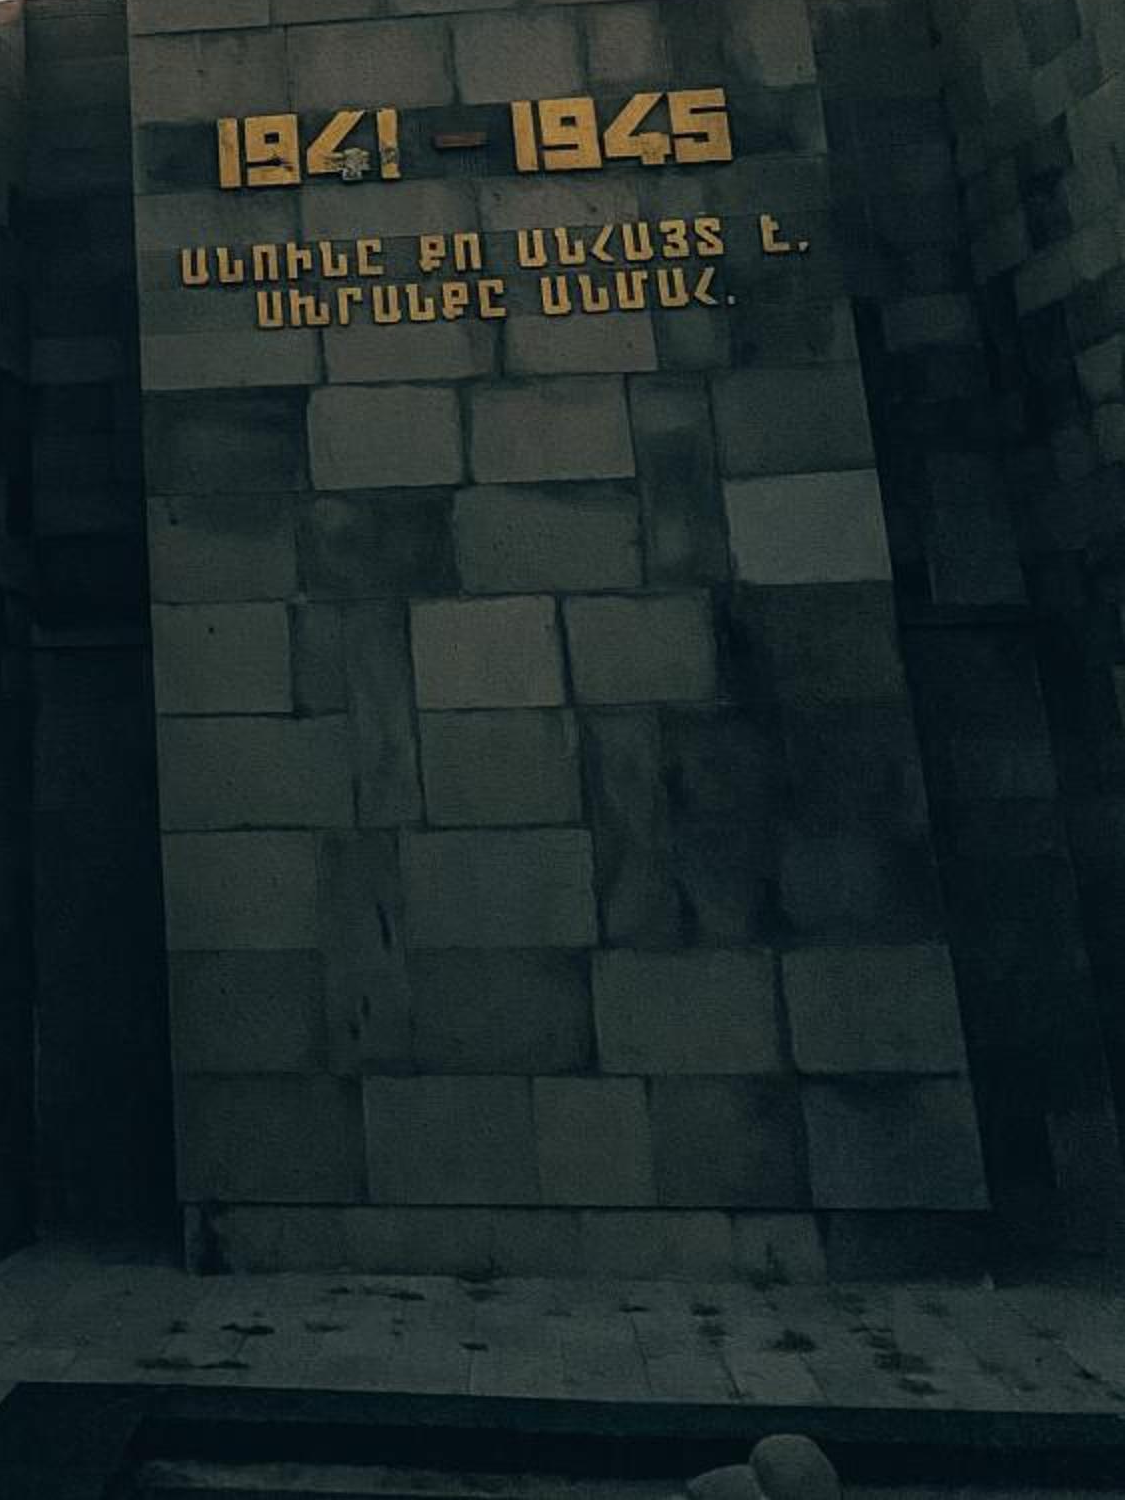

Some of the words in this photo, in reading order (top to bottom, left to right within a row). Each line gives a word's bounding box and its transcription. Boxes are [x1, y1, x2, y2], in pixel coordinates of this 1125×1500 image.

[217, 107, 402, 189] 1941
[510, 88, 733, 172] 1945
[419, 232, 482, 272] ՔՈ
[517, 217, 725, 267] ԱՆՀԱՅՏ
